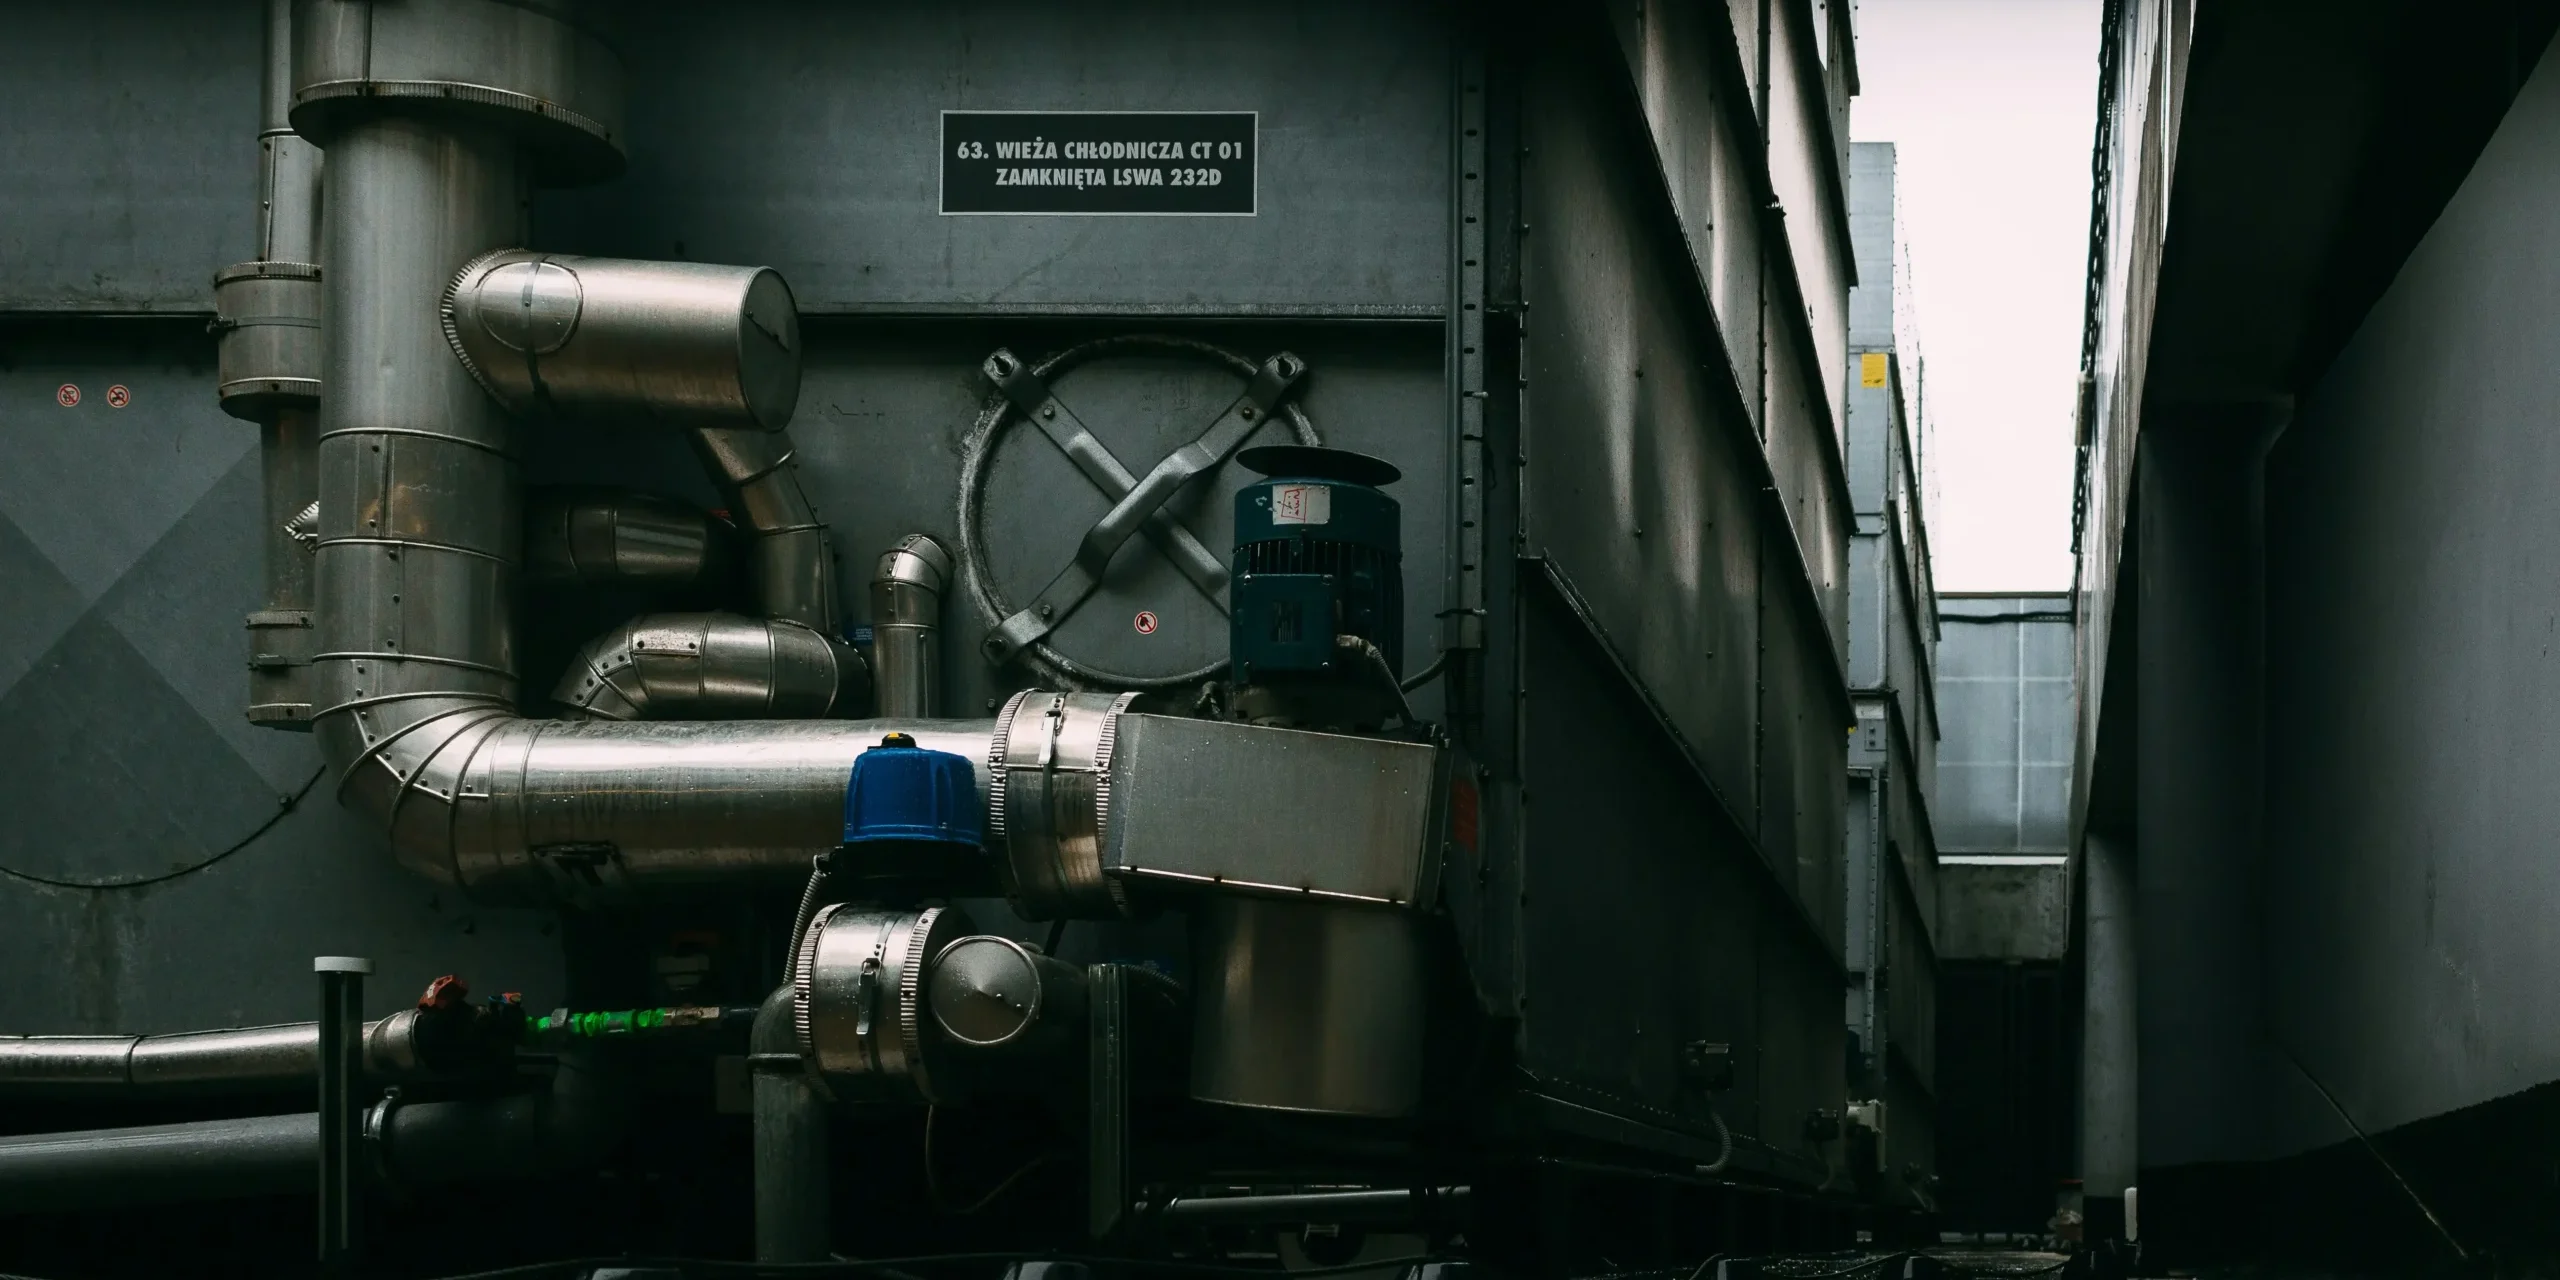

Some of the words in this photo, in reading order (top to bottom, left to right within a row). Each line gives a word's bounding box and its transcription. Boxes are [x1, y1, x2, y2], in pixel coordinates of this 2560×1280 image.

[957, 141, 989, 159] 63.
[996, 136, 1058, 159] WIEŻA
[1064, 141, 1183, 159] CHŁODNICZA
[1190, 141, 1213, 159] CT
[1218, 141, 1242, 159] 01
[995, 168, 1107, 190] ZAMKNIĘTA
[1113, 168, 1164, 186] LSWA
[1170, 168, 1222, 186] 232D
